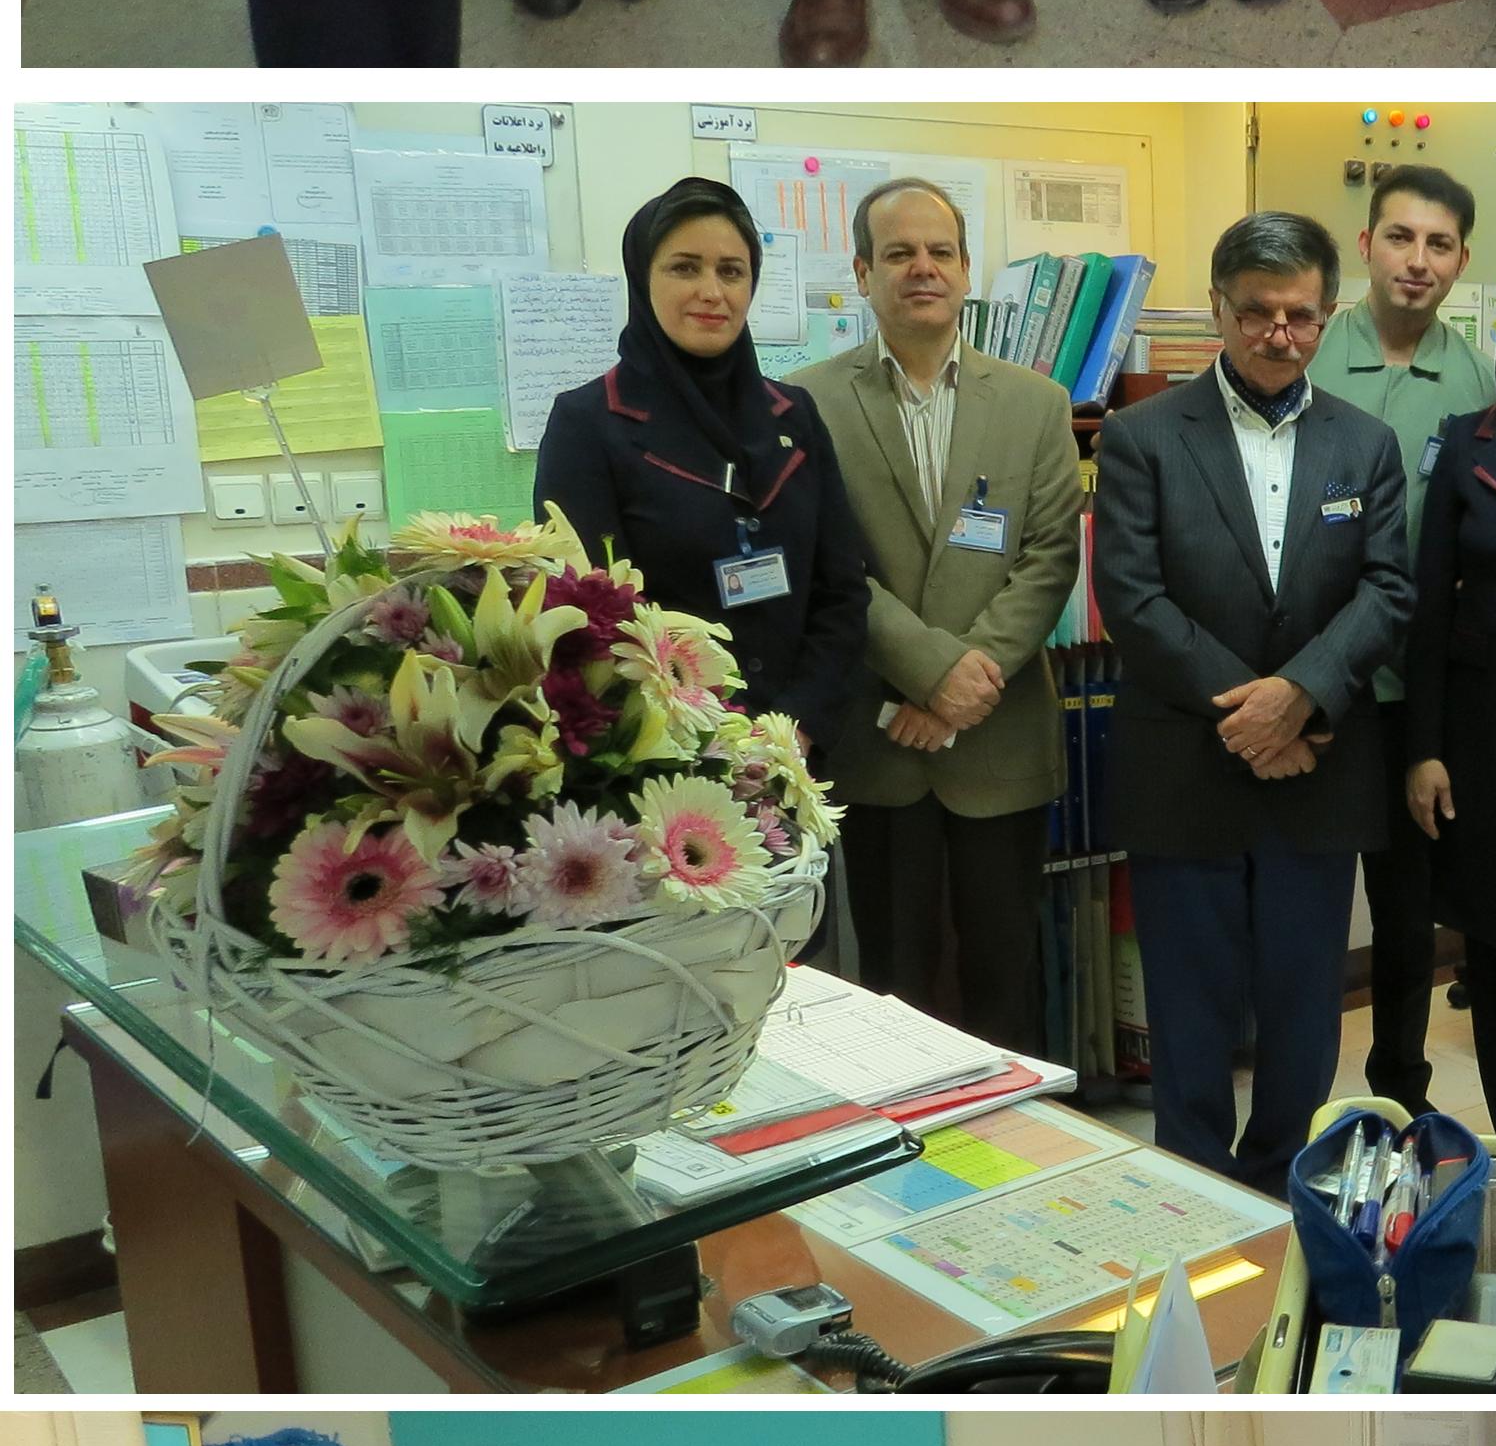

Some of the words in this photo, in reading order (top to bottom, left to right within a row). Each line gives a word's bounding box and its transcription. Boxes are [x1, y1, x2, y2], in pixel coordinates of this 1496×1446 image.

[492, 115, 527, 128] اعلانات
[528, 116, 544, 131] برد
[697, 113, 735, 130] آموزشی
[737, 116, 752, 130] برد
